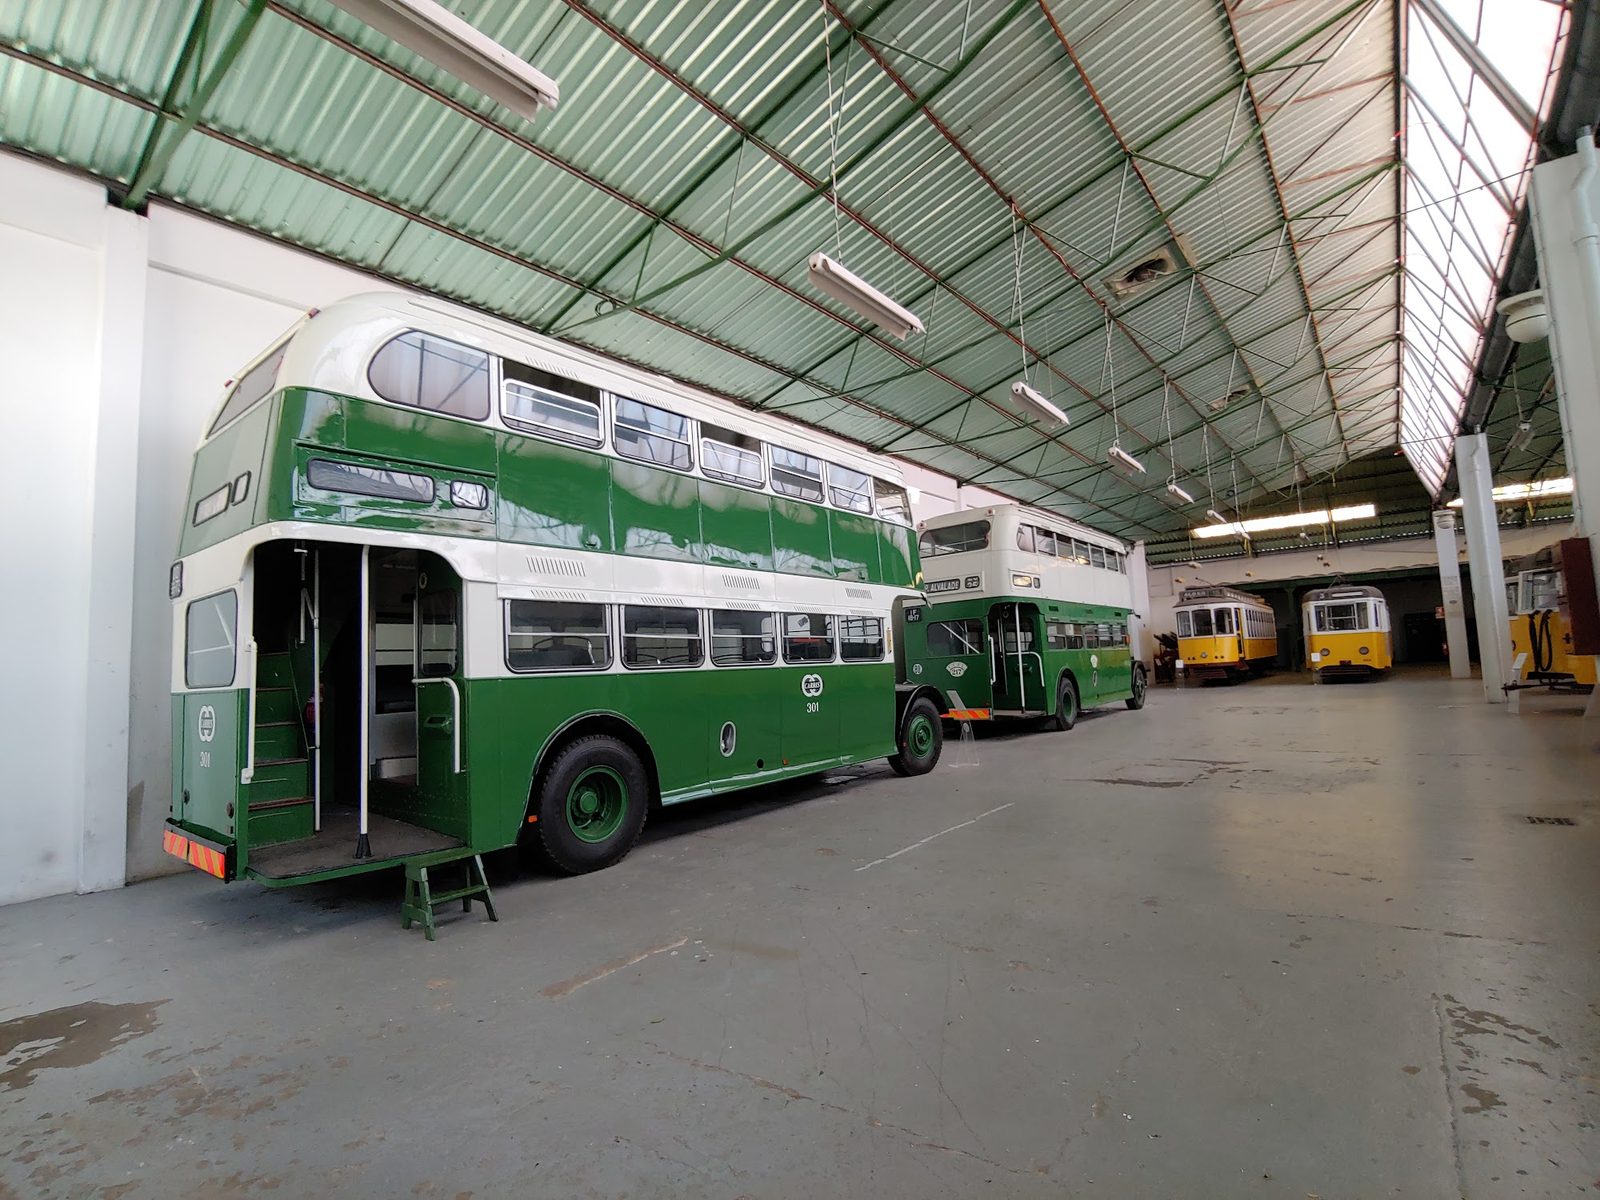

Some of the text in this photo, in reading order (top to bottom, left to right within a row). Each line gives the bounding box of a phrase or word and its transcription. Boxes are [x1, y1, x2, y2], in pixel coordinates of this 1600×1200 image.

[930, 581, 959, 592] ALVALADE
[806, 702, 819, 713] 301
[200, 751, 211, 768] 301
